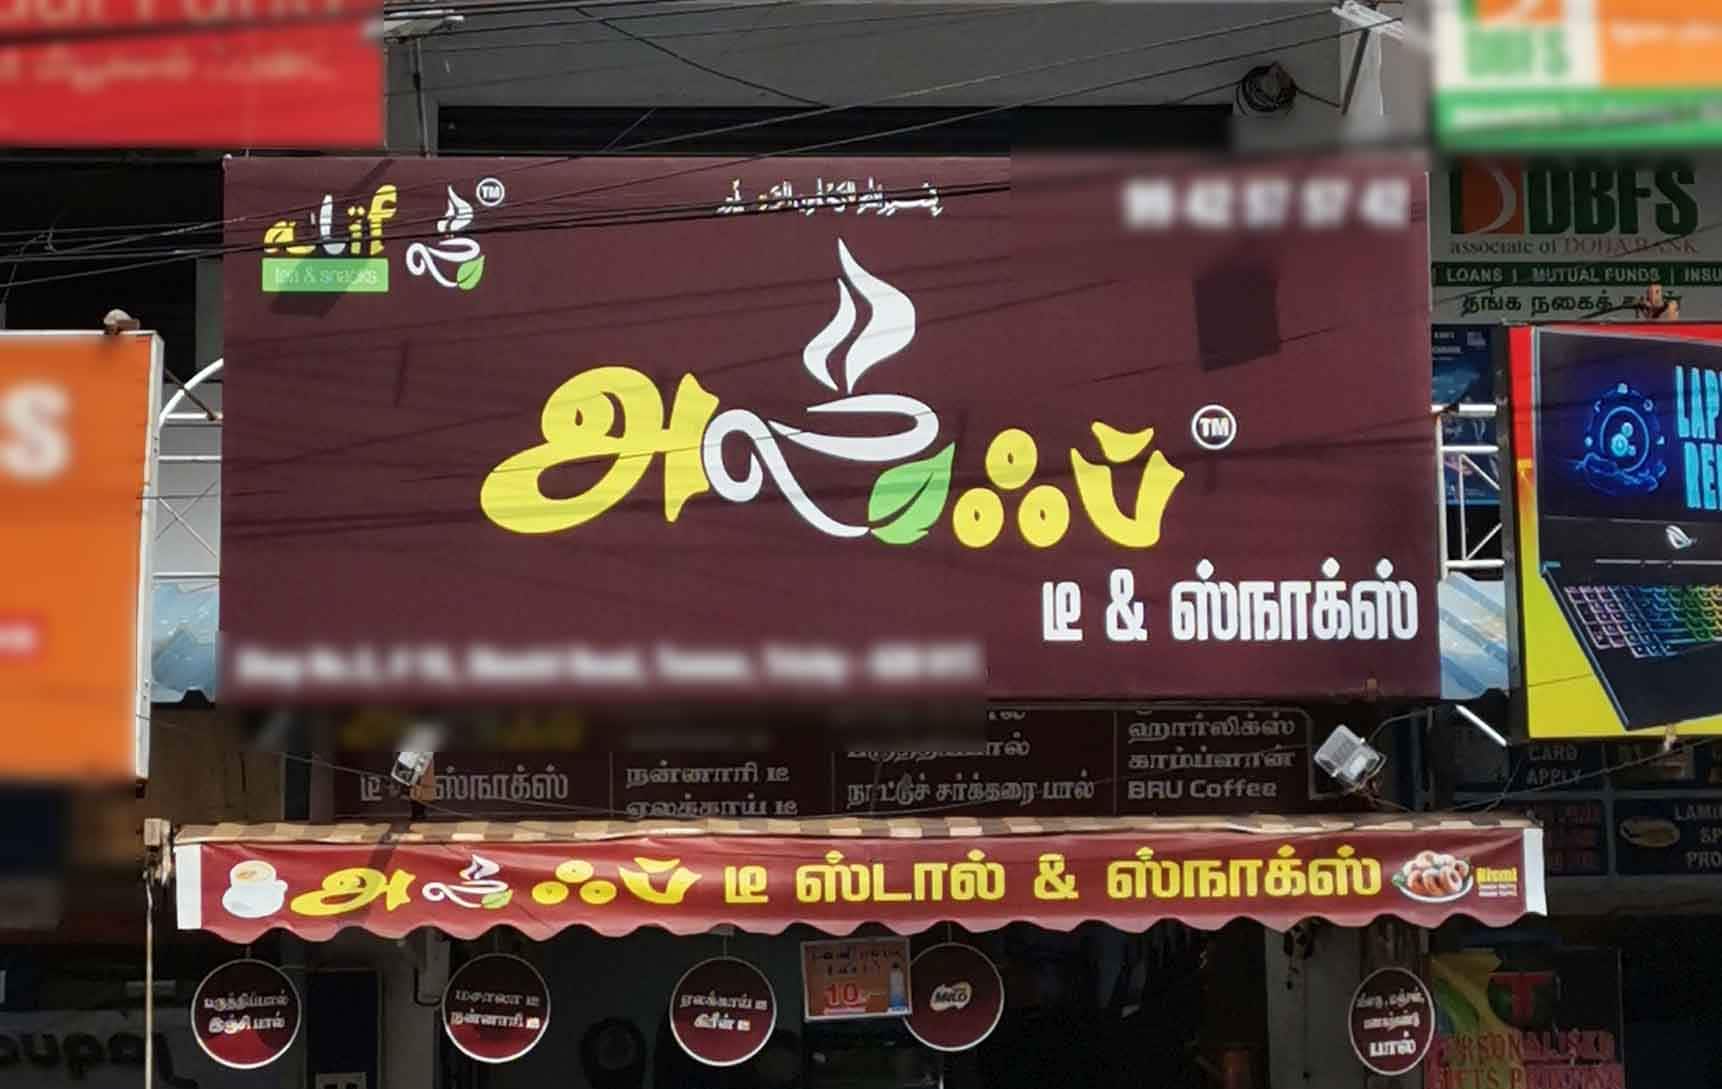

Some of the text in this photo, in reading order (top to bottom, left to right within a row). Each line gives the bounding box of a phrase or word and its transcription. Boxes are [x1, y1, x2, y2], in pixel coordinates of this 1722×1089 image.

[1450, 237, 1533, 255] associate
[1538, 236, 1560, 254] of
[1447, 267, 1503, 283] LOANS
[1533, 267, 1600, 283] MUTUAL
[1604, 267, 1660, 283] FUNDS
[1675, 365, 1722, 439] LAP
[1042, 557, 1419, 641] டீ & ஸ்நாக்ஸ்
[1127, 711, 1296, 744] ஹார்லிக்ஸ்
[624, 759, 759, 790] நன்னாரி
[1041, 768, 1096, 801] பால்
[1127, 778, 1277, 800] BRU Coffee
[1671, 802, 1722, 822] LAMI
[724, 864, 769, 902] டீ
[795, 850, 1006, 903] ஸ்டால்
[1033, 852, 1079, 899] &
[1106, 844, 1382, 899] ஸ்நாக்ஸ்
